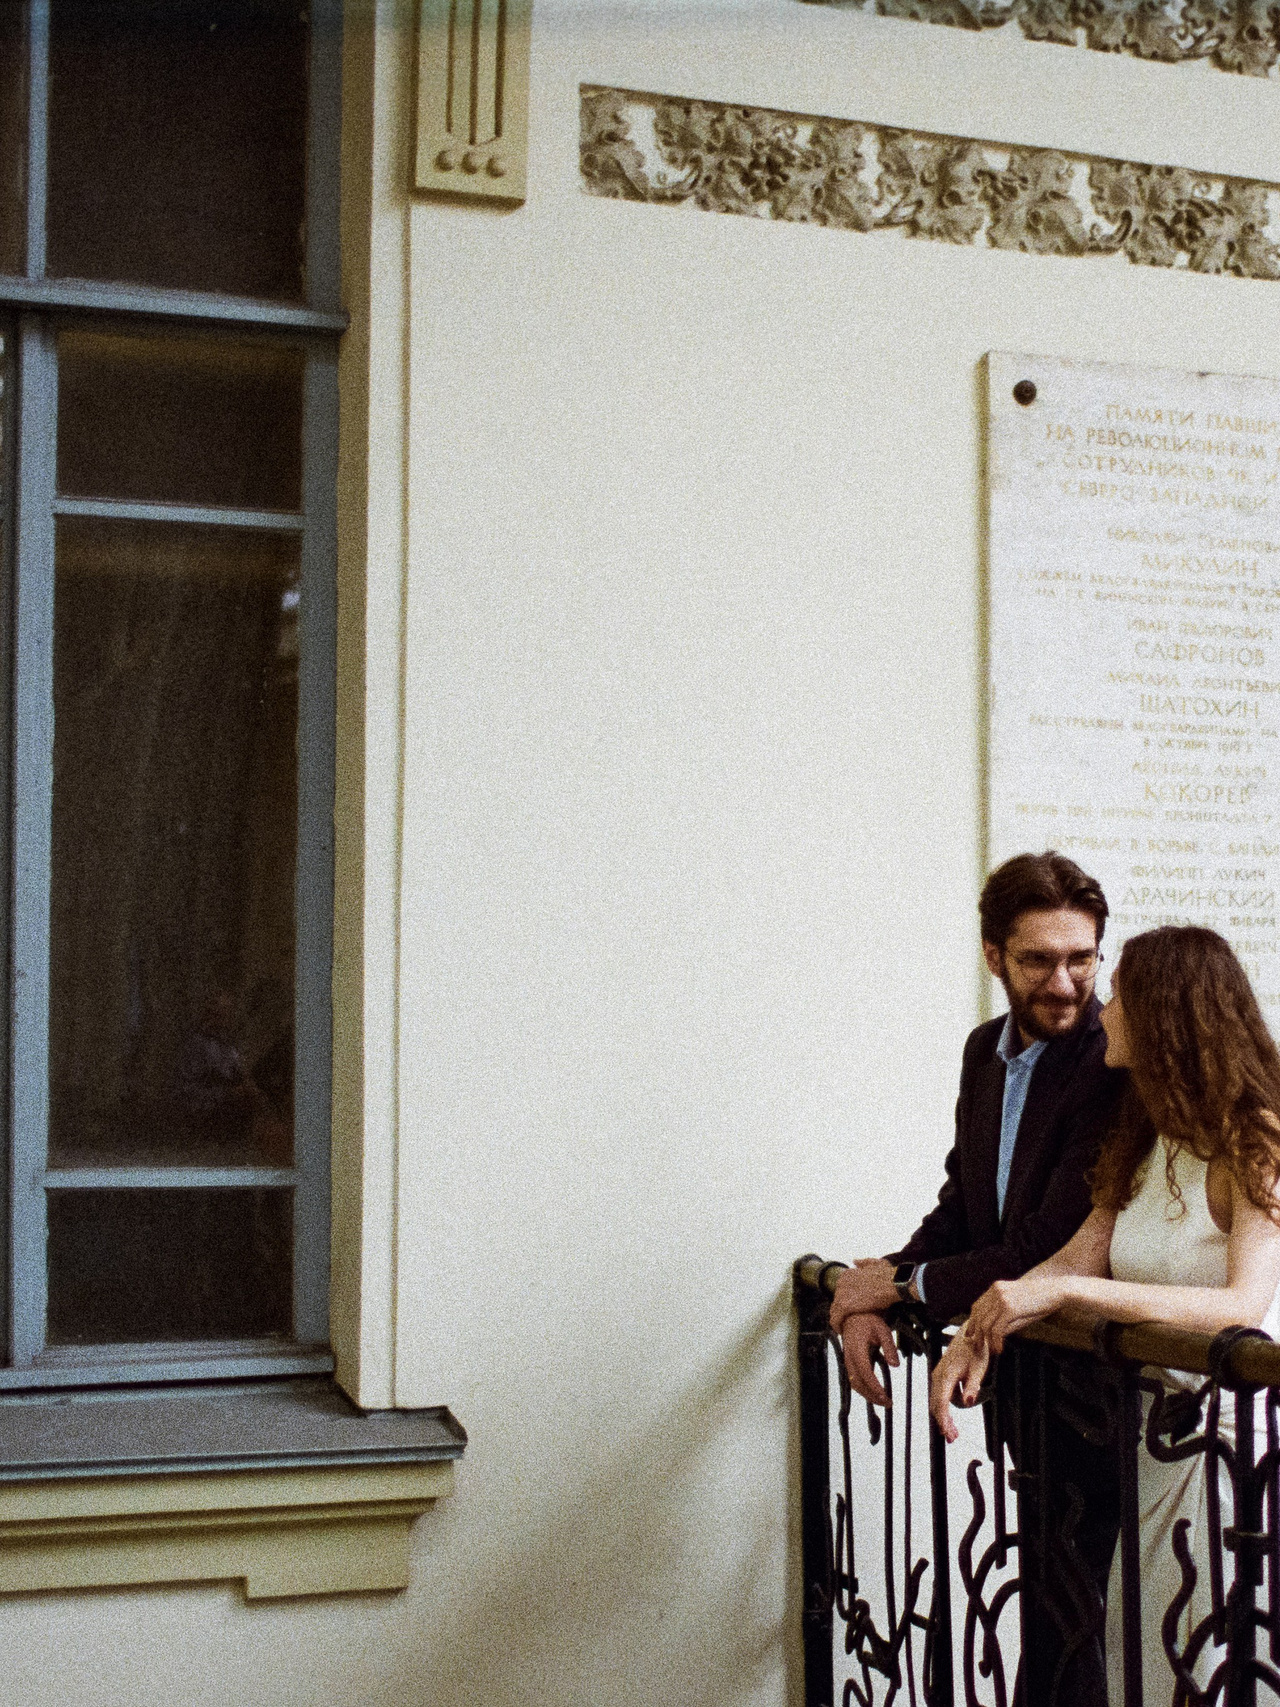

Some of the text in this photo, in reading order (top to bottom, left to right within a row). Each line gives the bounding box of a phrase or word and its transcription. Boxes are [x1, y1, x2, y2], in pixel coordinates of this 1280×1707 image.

[1106, 404, 1194, 428] ПАМЯТИ
[1046, 424, 1075, 442] НА
[1063, 454, 1216, 482] СОТРУДНИКОВ
[1134, 640, 1265, 667] САФРОНОВ
[1140, 694, 1259, 719] ШАТОХИН
